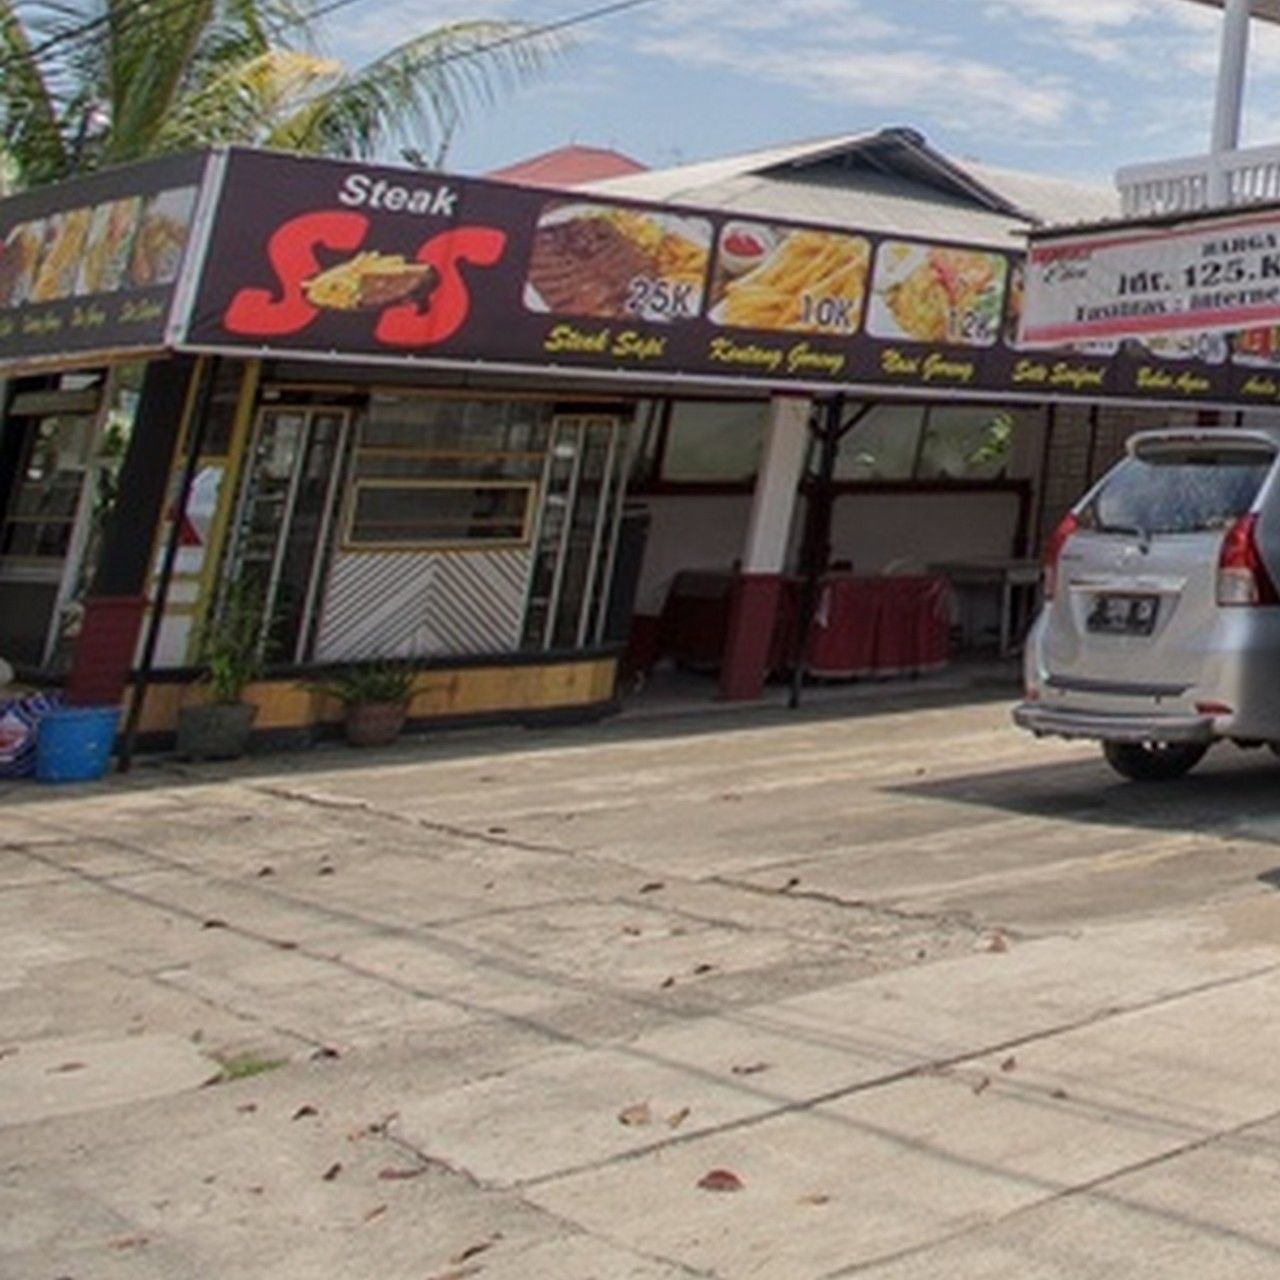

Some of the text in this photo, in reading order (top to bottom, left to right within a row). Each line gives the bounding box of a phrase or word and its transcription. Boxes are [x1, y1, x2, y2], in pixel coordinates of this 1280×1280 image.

[338, 173, 458, 217] Steak
[1202, 233, 1276, 257] HARGA
[627, 277, 694, 315] 25K
[799, 292, 854, 327] 10K
[543, 323, 610, 354] Steak
[708, 336, 783, 371] Kentang
